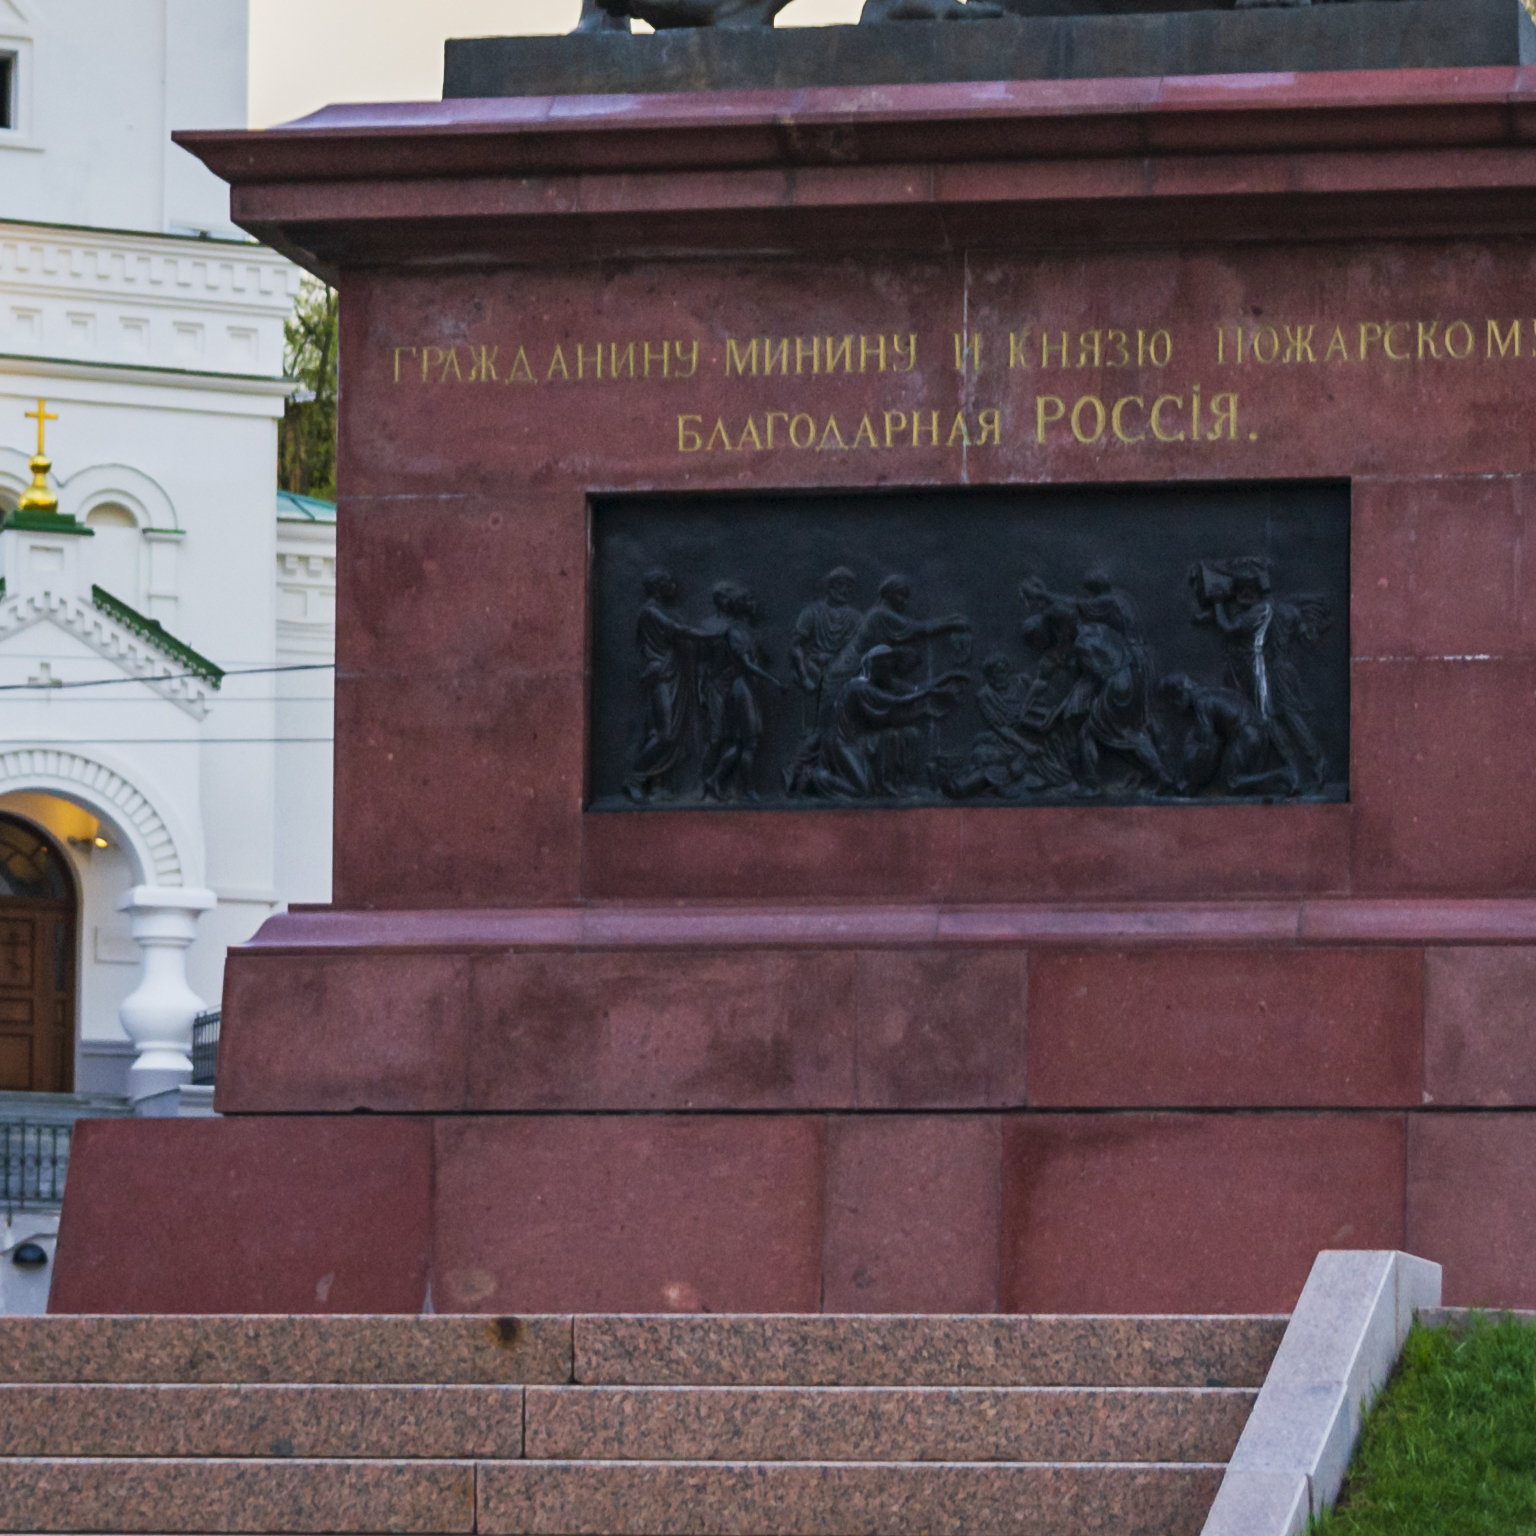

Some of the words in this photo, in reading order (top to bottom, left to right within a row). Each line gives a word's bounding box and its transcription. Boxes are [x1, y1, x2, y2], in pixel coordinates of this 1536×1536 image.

[392, 339, 700, 385] ГРАЖДАНИНУ
[724, 333, 918, 378] МИНИНУ
[953, 331, 981, 370] И
[1008, 328, 1173, 369] КНЯЗЮ
[676, 408, 1002, 453] БЛАГОДАРНАЯ
